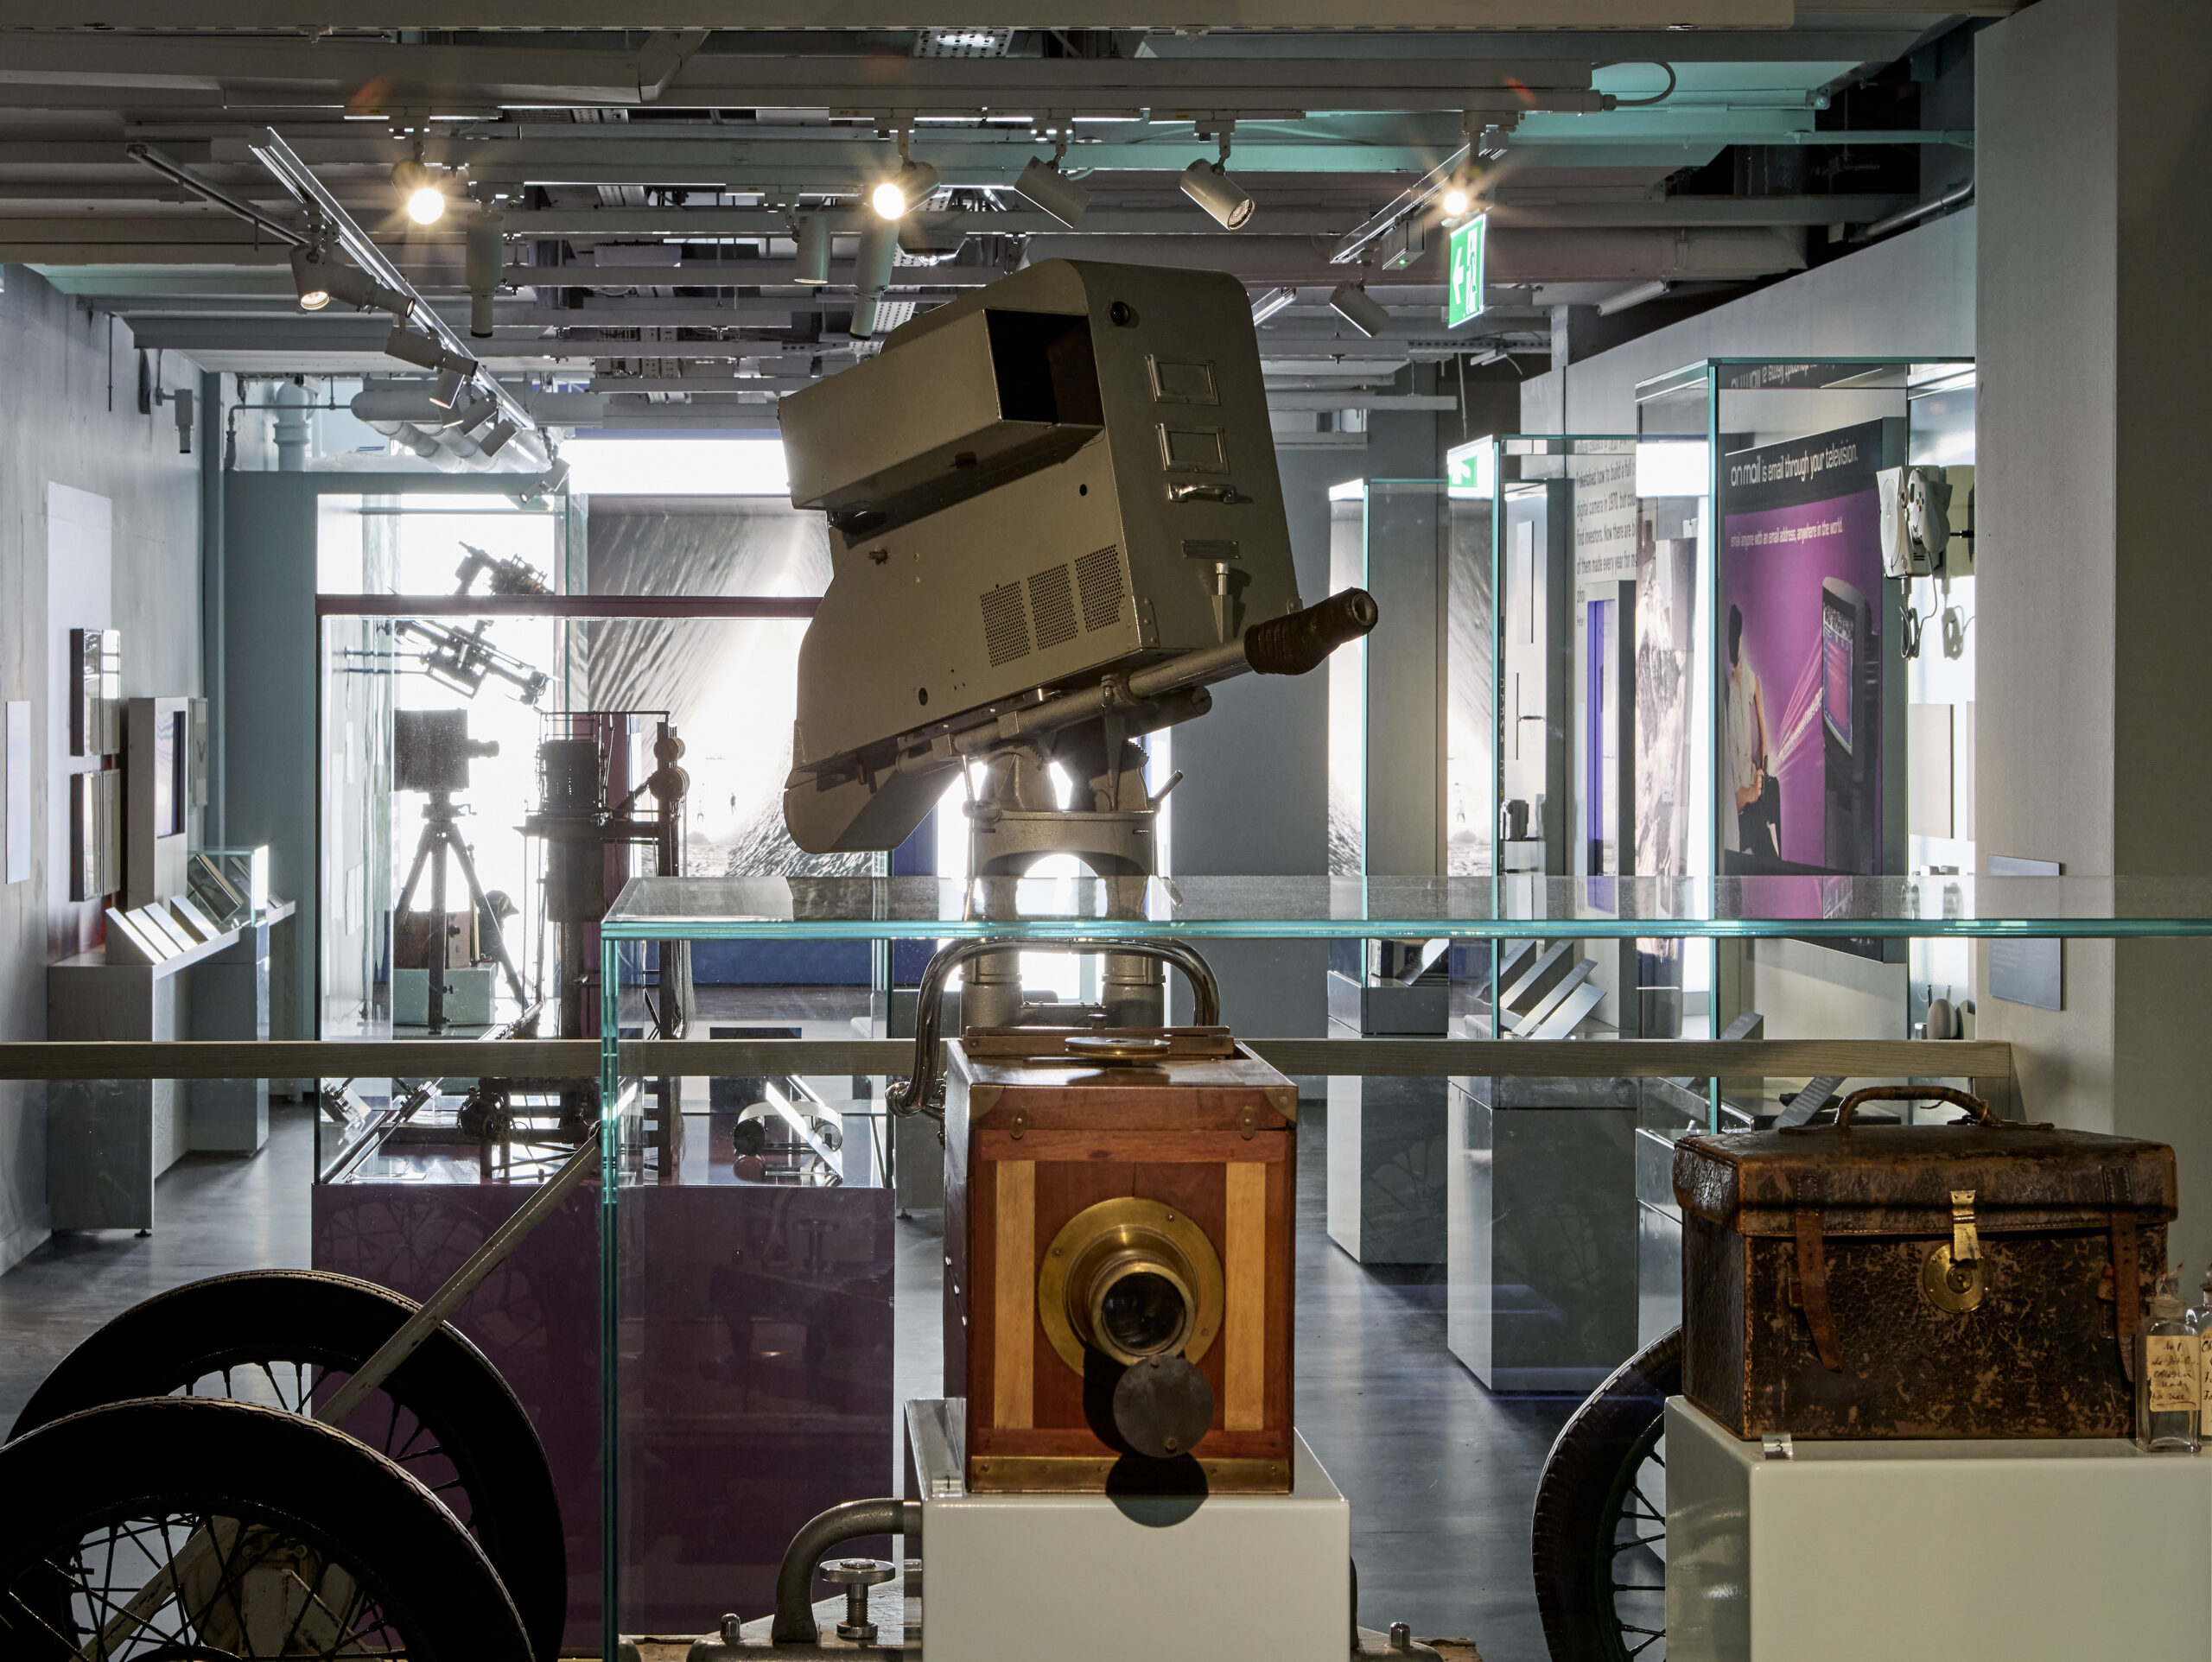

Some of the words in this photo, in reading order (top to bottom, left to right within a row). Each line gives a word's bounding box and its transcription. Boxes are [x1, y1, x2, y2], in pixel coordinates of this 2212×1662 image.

[1762, 460, 1767, 482] is
[1768, 455, 1784, 481] email
[1785, 450, 1809, 482] through
[1809, 452, 1825, 479] your
[1825, 439, 1859, 470] television.
[1764, 531, 1769, 544] an
[1769, 527, 1780, 544] email
[1797, 522, 1817, 543] anywhere
[1816, 520, 1821, 537] in
[1821, 519, 1830, 537] the
[1774, 1438, 1783, 1452] 3
